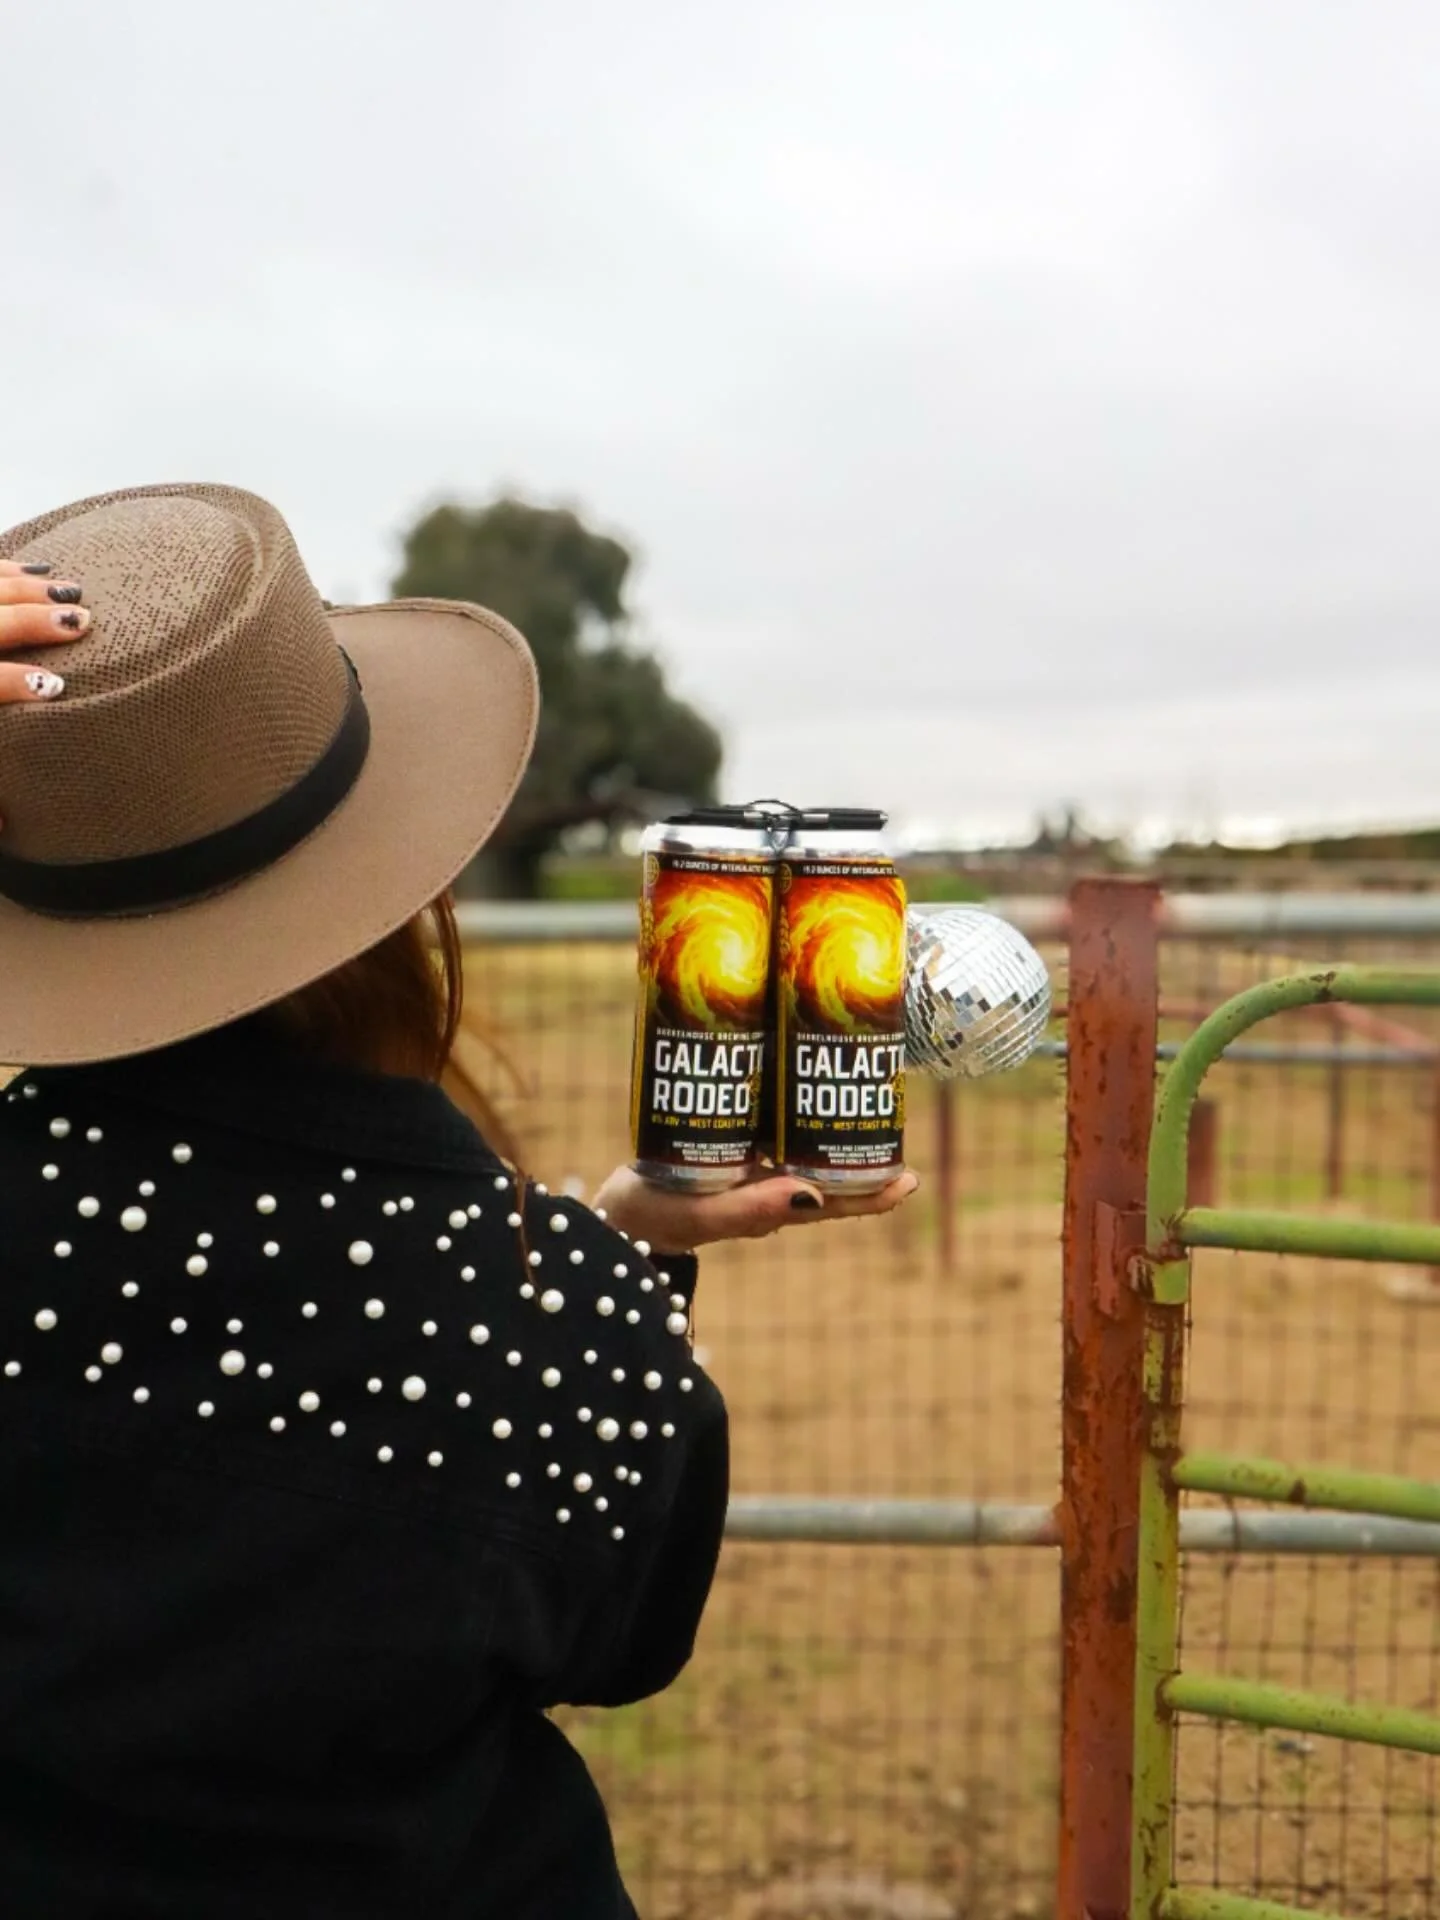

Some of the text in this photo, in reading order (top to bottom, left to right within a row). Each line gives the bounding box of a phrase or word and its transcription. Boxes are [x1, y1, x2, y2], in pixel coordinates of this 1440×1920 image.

[652, 1077, 750, 1115] RODEO
[796, 1083, 894, 1118] RODEO
[688, 1117, 711, 1129] WEST
[832, 1121, 856, 1131] WEST
